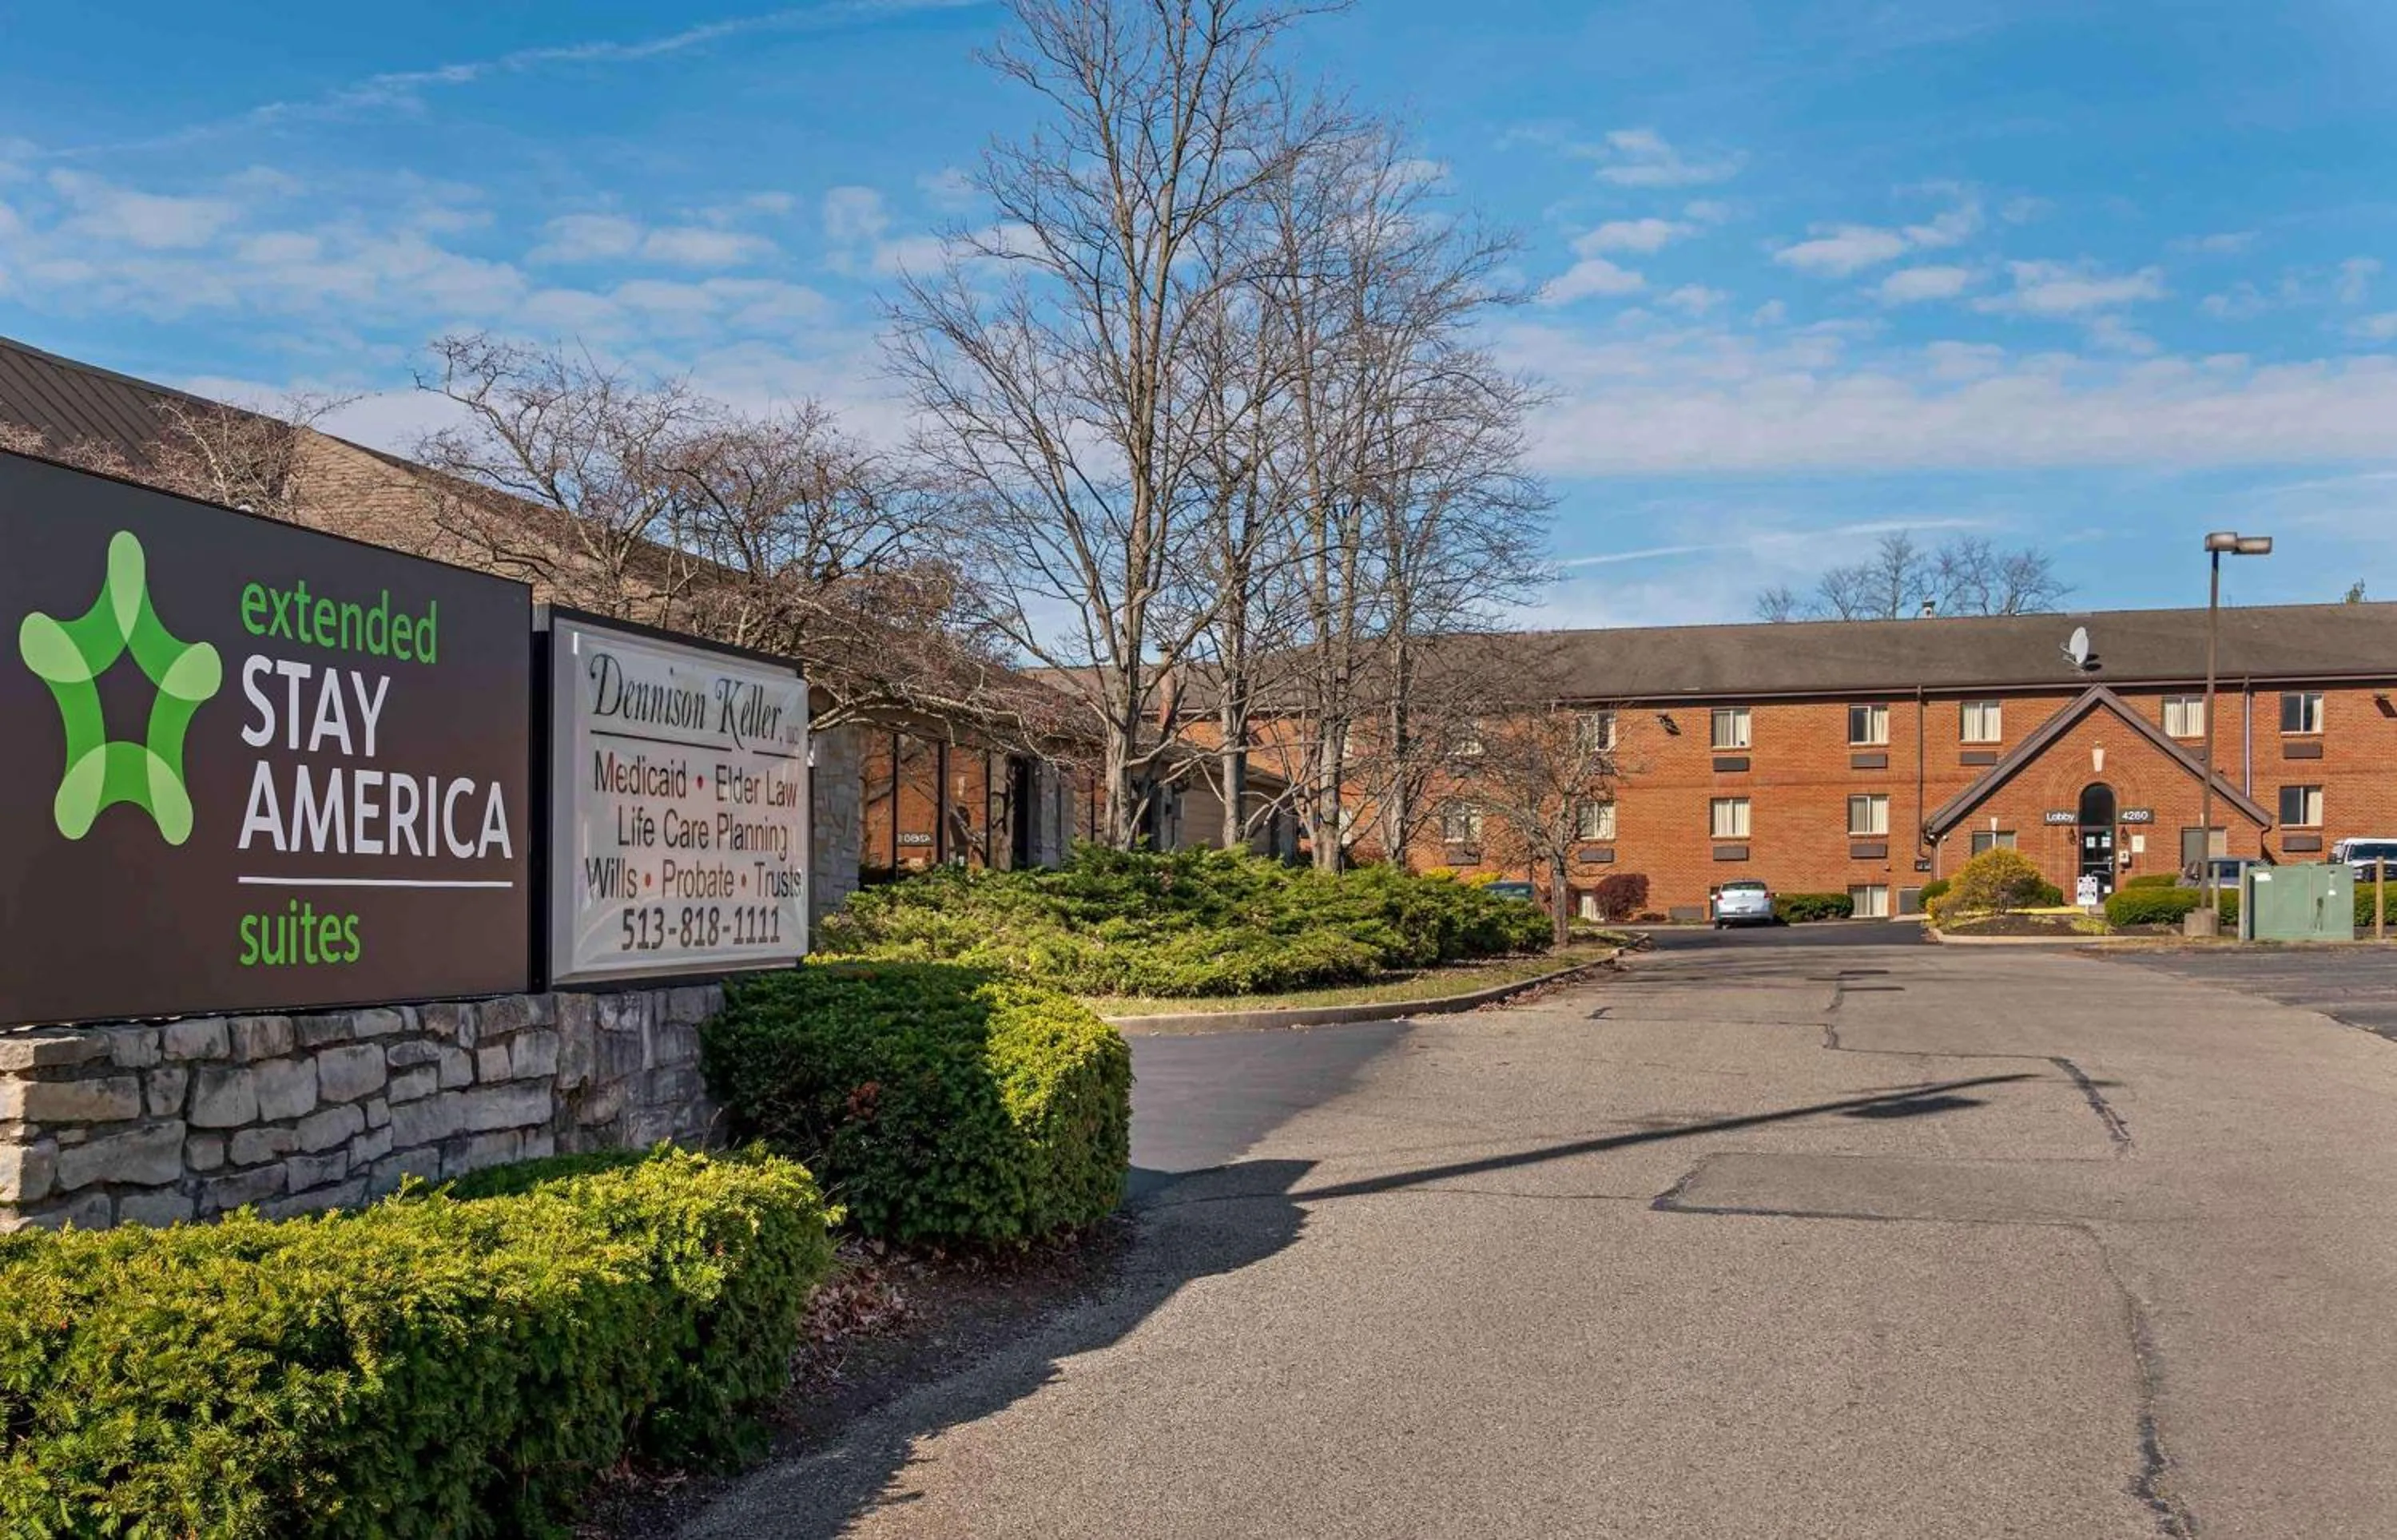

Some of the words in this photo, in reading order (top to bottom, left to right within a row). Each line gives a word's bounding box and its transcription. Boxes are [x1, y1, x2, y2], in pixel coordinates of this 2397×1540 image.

[241, 581, 437, 664] extended
[241, 654, 391, 756] STAY
[590, 653, 706, 730] Dennison
[594, 750, 687, 799] Medicaid
[715, 764, 760, 804] Elder
[766, 770, 797, 807] Law
[237, 760, 512, 859] AMERICA
[618, 804, 654, 847] Life
[664, 809, 710, 850] Care
[718, 812, 788, 862] Planning
[2045, 812, 2075, 822] Lobby
[2122, 811, 2149, 820] 4260
[585, 857, 638, 899] Wills
[662, 859, 734, 899] Probate
[754, 862, 801, 897] Trusts
[240, 899, 360, 965] suites
[622, 906, 781, 951] 513-818-1111
